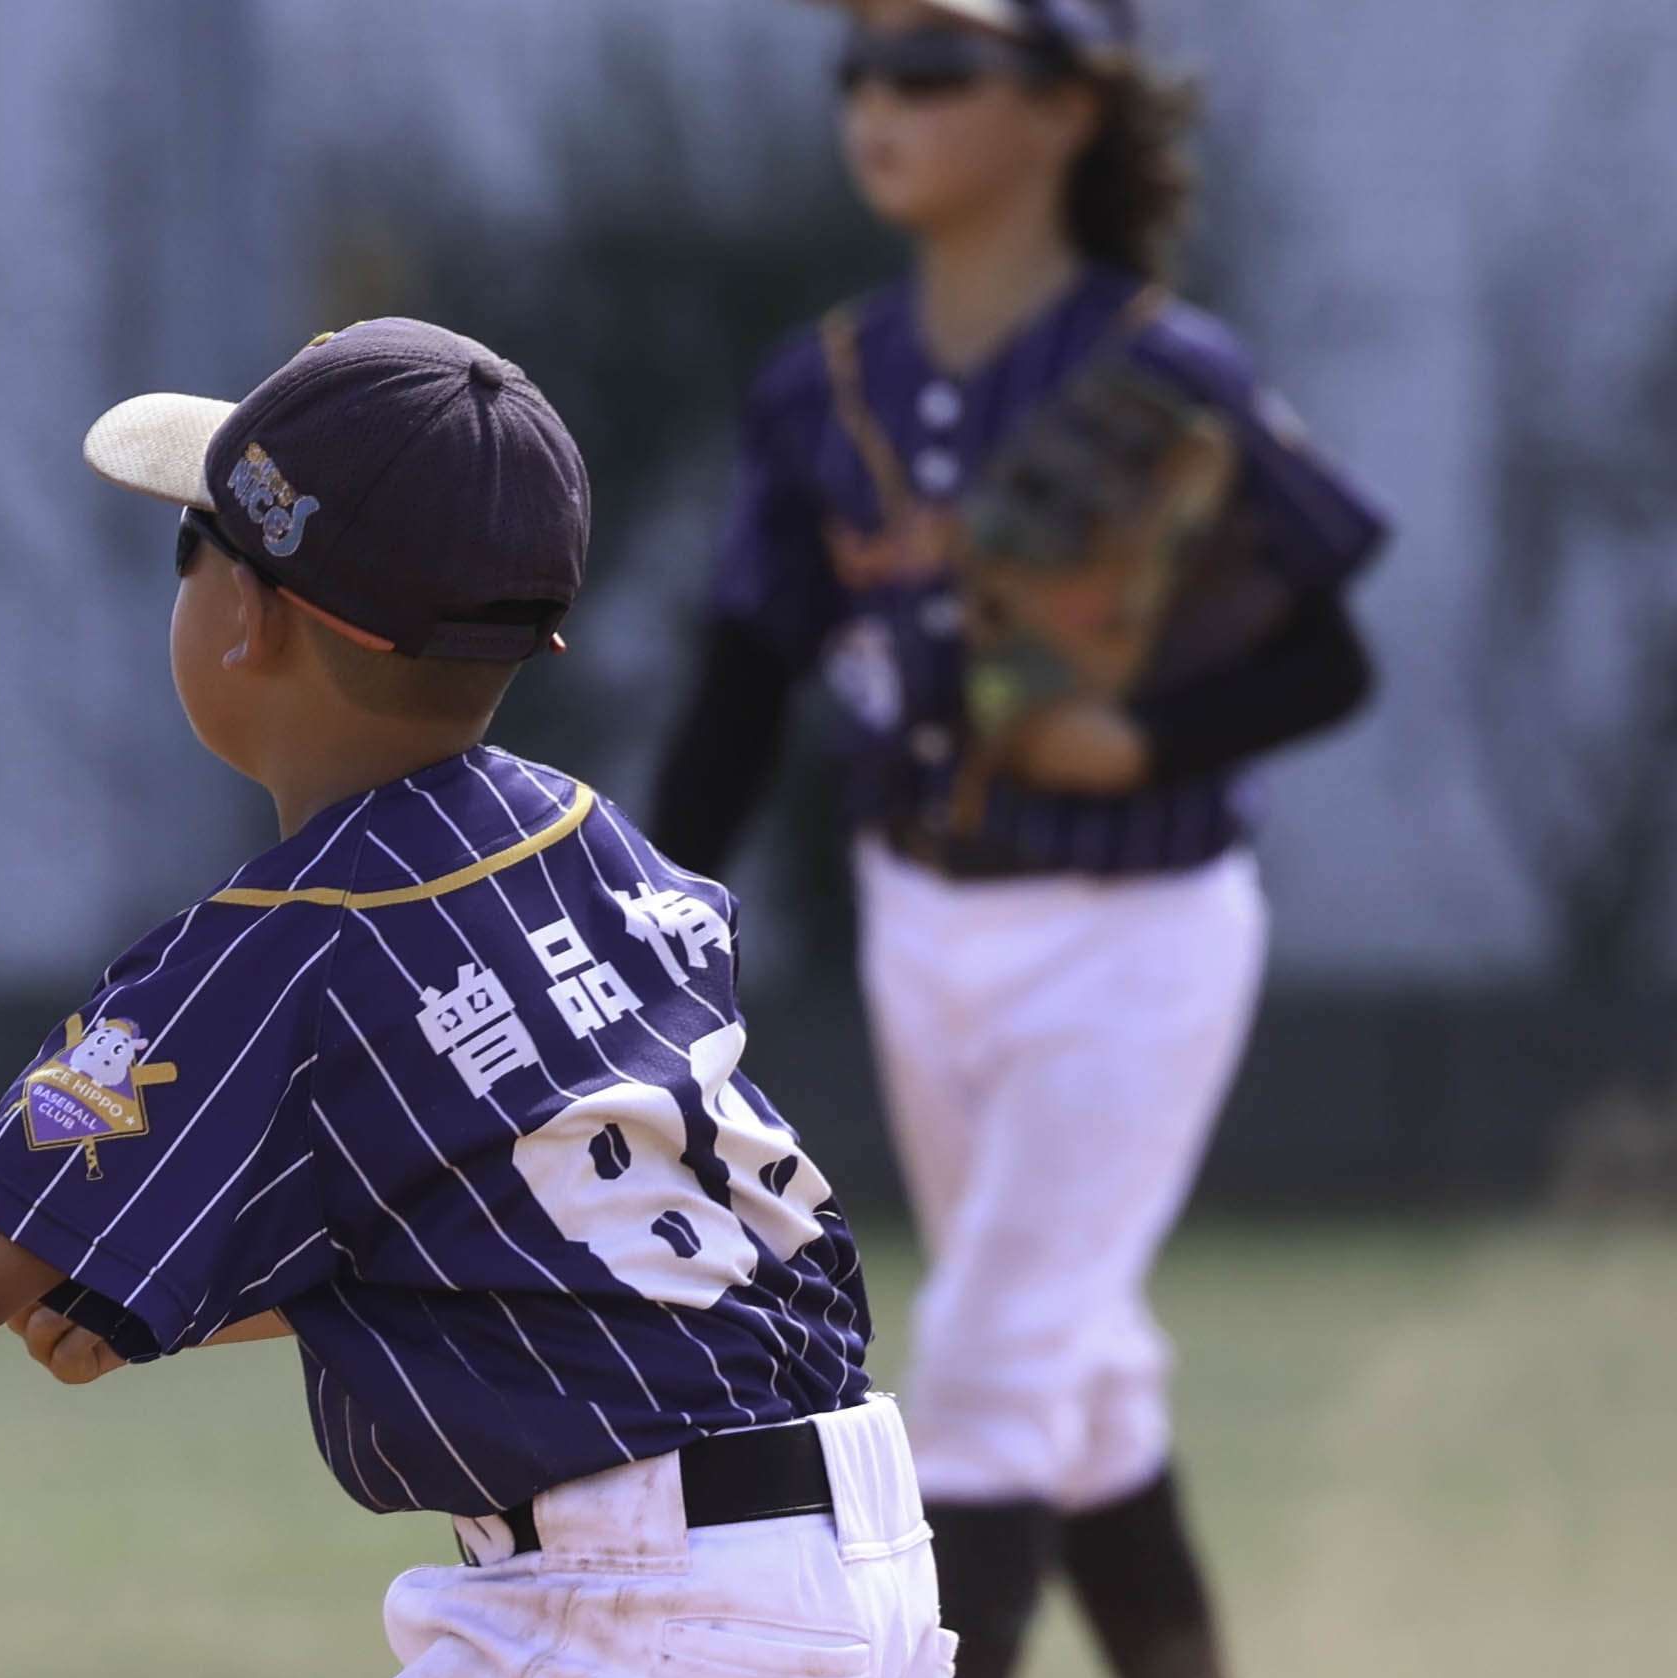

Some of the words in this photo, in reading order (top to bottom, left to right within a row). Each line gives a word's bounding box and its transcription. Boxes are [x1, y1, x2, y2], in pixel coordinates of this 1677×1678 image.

[32, 1084, 98, 1130] BASEBALL
[38, 1102, 76, 1130] CLUB
[72, 1079, 123, 1117] HIPPO
